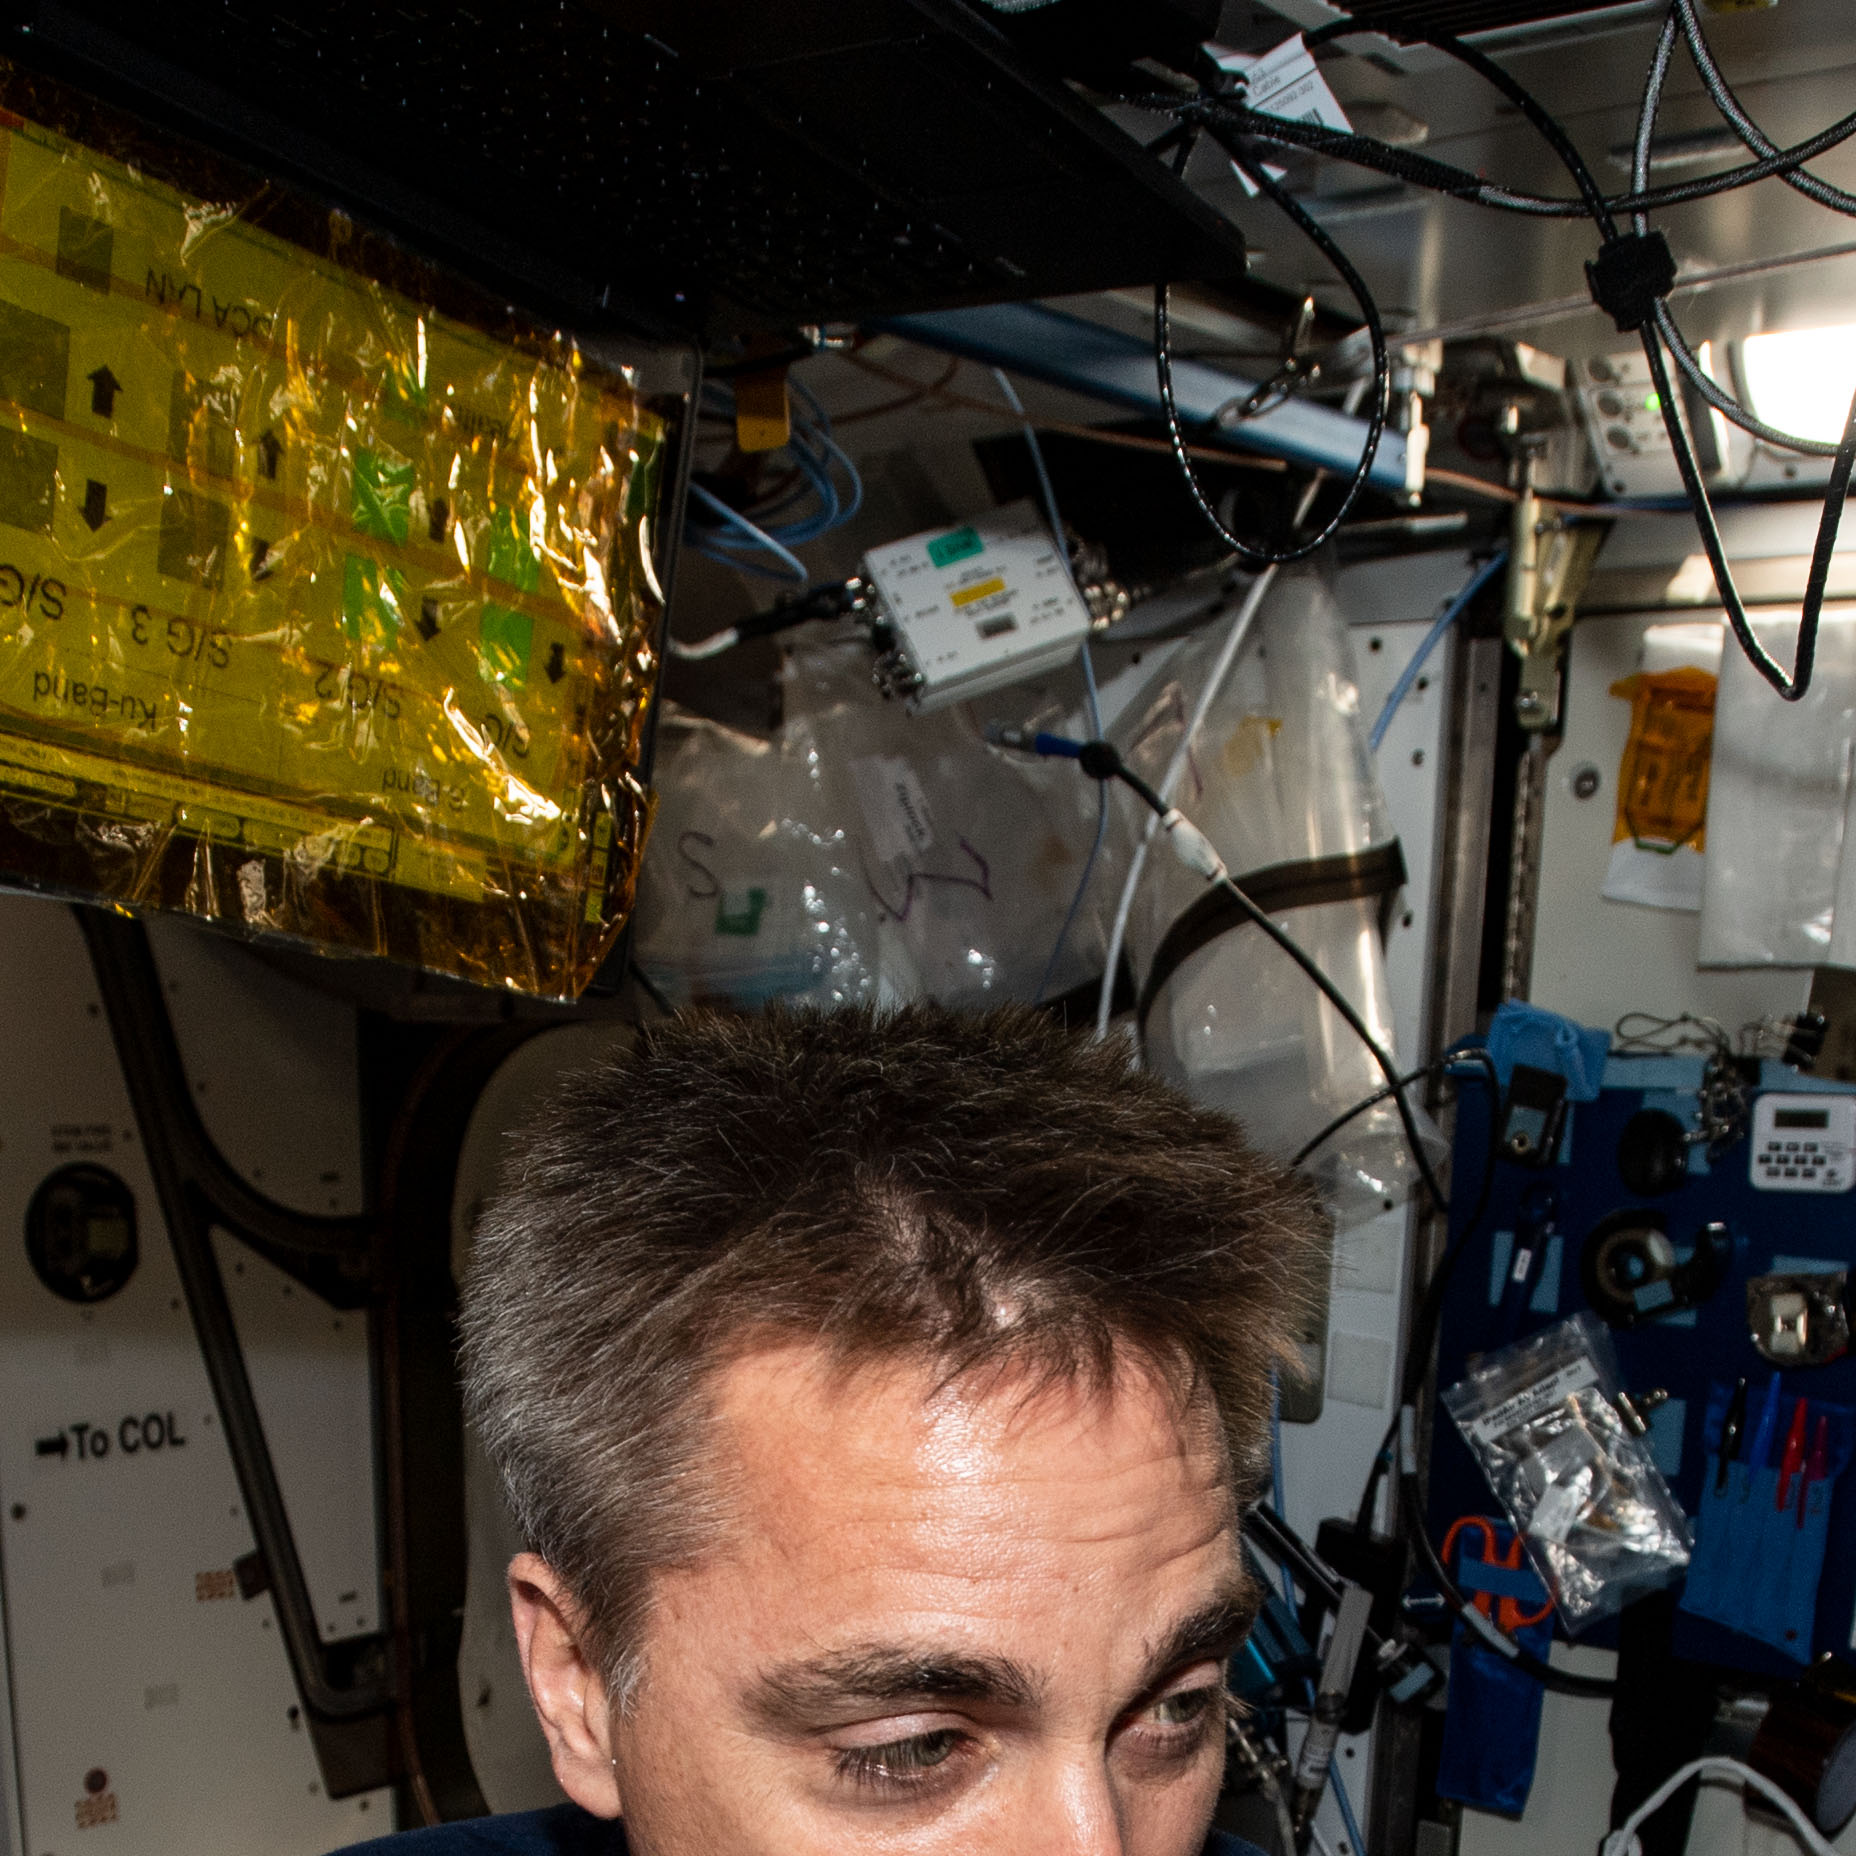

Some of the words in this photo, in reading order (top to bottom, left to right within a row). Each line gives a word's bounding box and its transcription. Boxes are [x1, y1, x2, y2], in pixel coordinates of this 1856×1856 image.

[130, 604, 152, 648] 3
[165, 623, 234, 670] S/G
[32, 669, 158, 732] Ku-Band
[69, 1421, 110, 1461] To
[118, 1411, 186, 1454] COL
